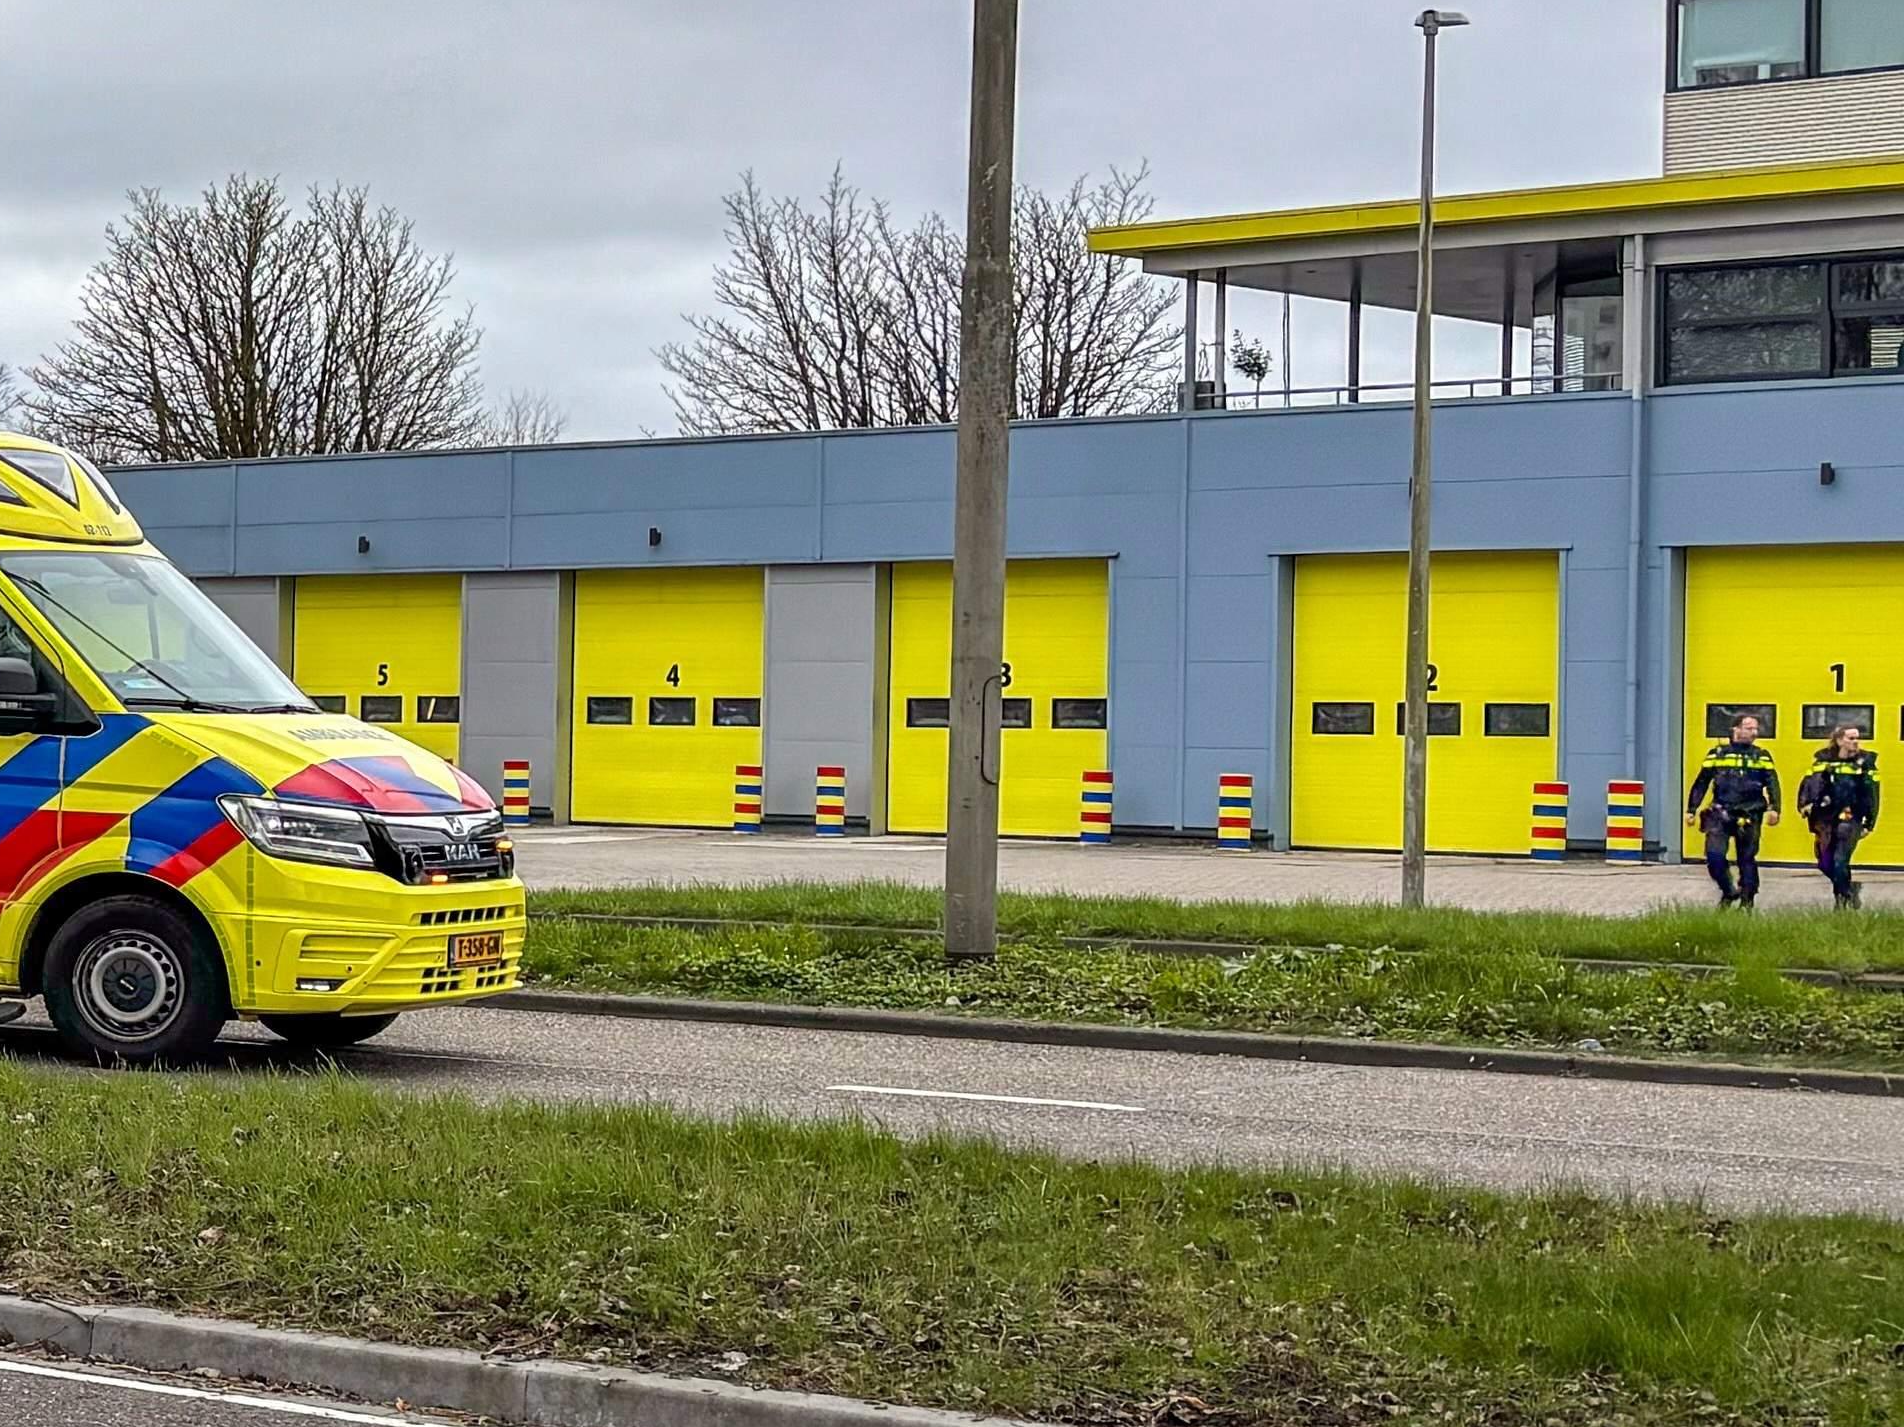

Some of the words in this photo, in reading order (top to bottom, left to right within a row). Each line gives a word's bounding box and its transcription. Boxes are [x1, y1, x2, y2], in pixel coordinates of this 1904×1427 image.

[377, 663, 388, 686] 5
[666, 663, 680, 687] 4
[1427, 664, 1438, 691] 2
[1830, 663, 1844, 692] 1
